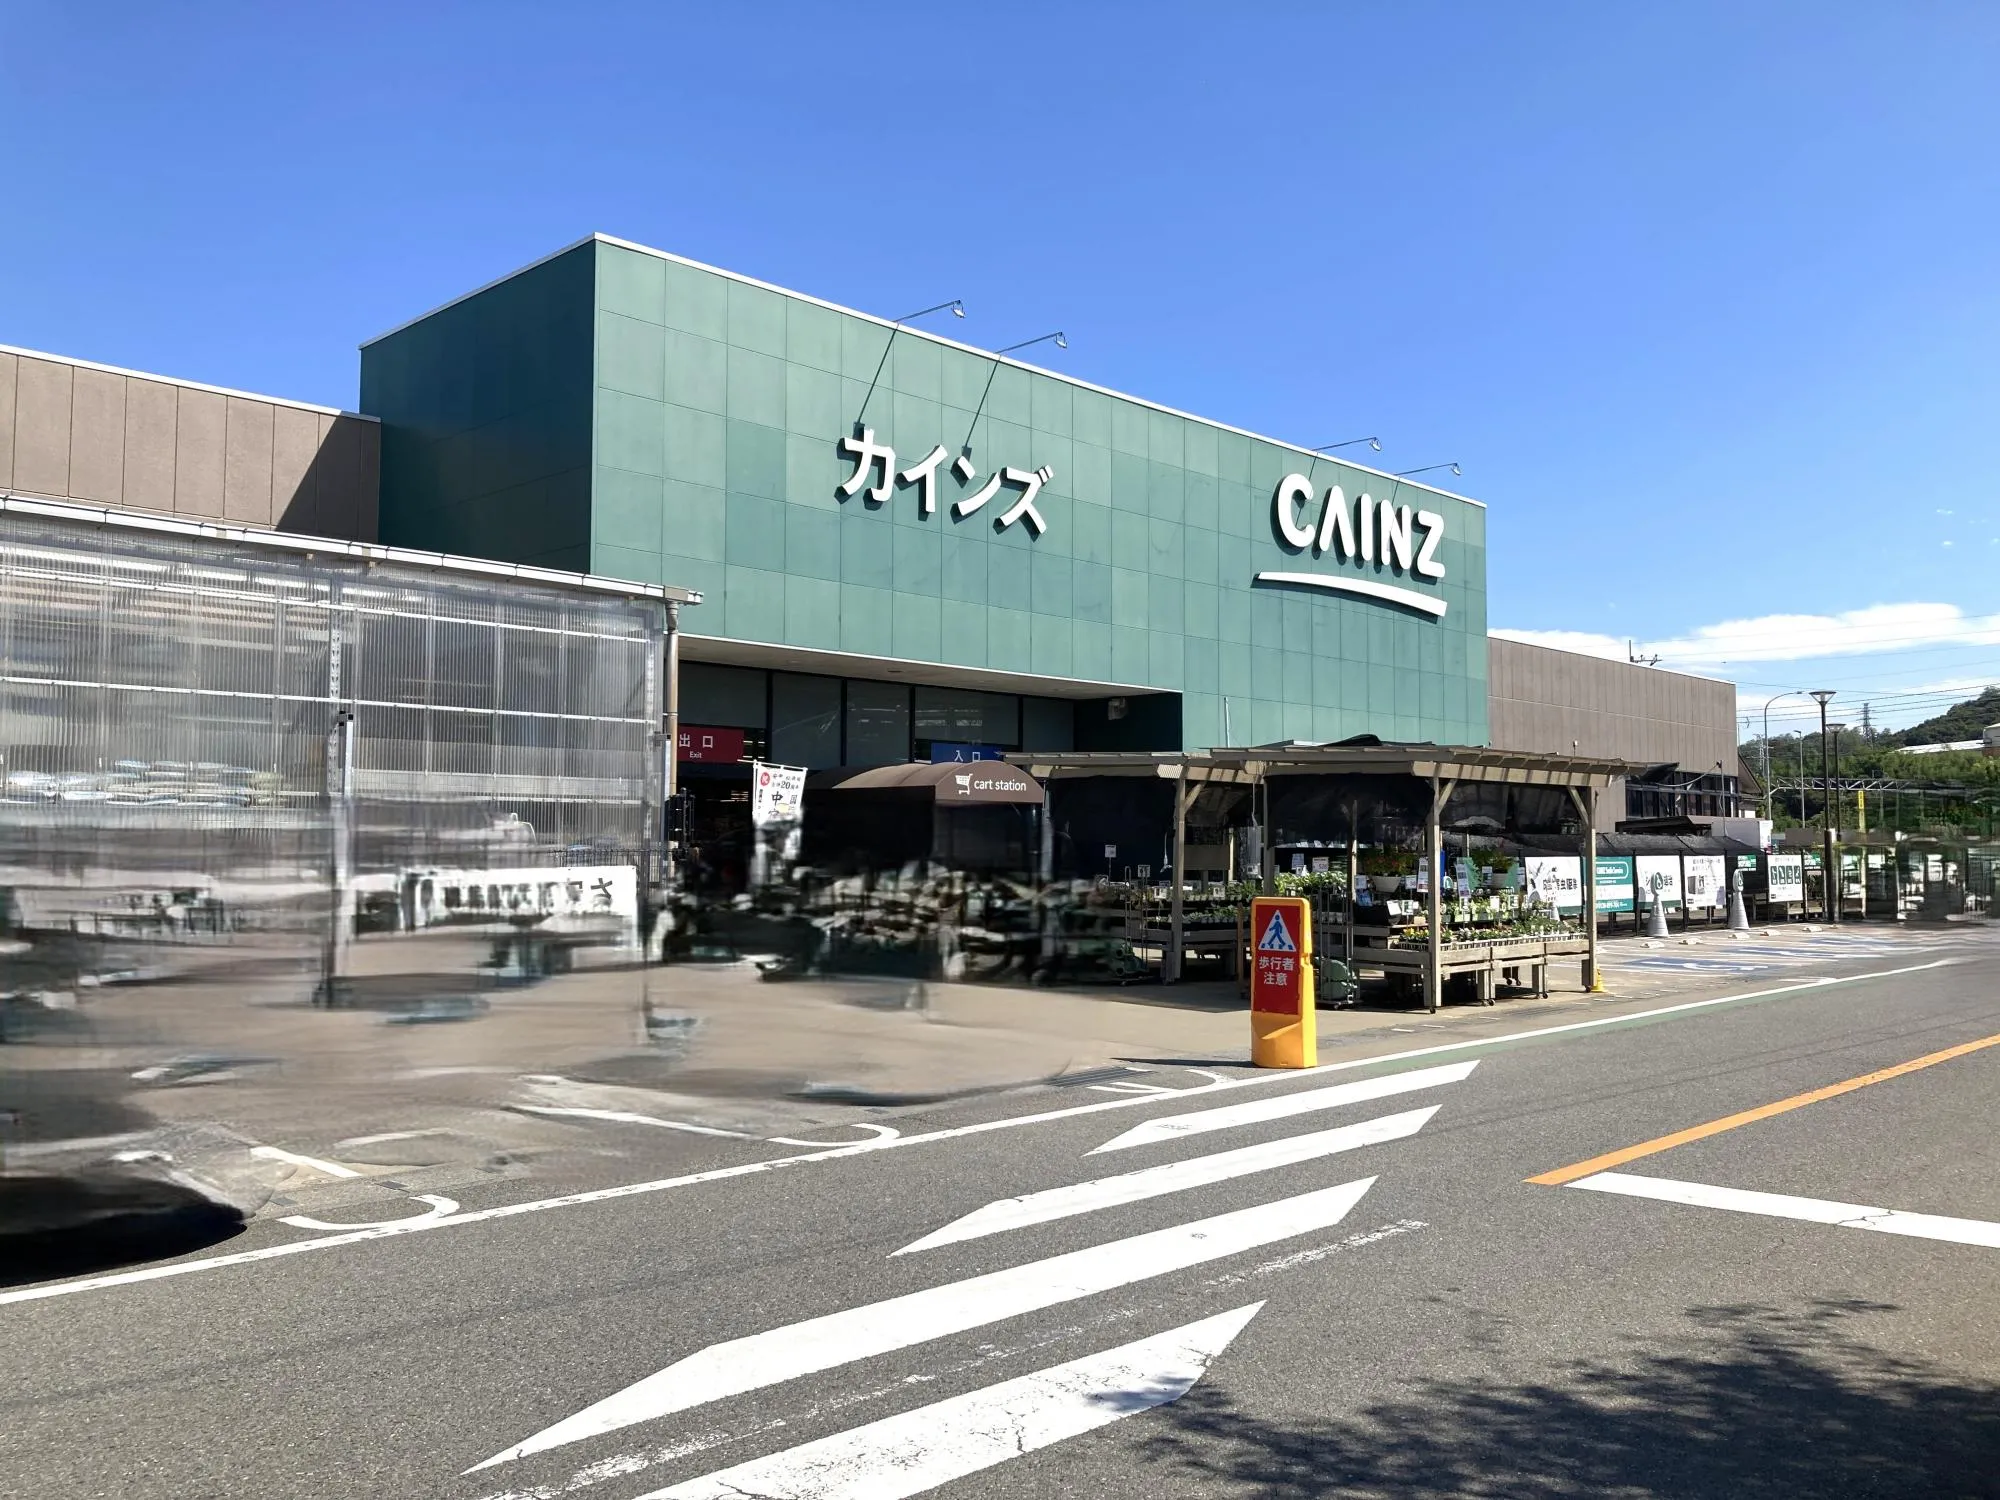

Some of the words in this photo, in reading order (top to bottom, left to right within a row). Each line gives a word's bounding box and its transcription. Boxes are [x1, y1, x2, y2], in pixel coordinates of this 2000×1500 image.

[838, 428, 1055, 538] カインズ
[1274, 473, 1446, 581] CAINZ
[679, 733, 714, 749] 出口
[689, 751, 702, 759] Exit
[954, 749, 981, 762] 入口
[973, 779, 994, 790] cart
[995, 778, 1027, 791] station
[1258, 955, 1295, 971] 歩行者
[1263, 971, 1288, 986] 注意
